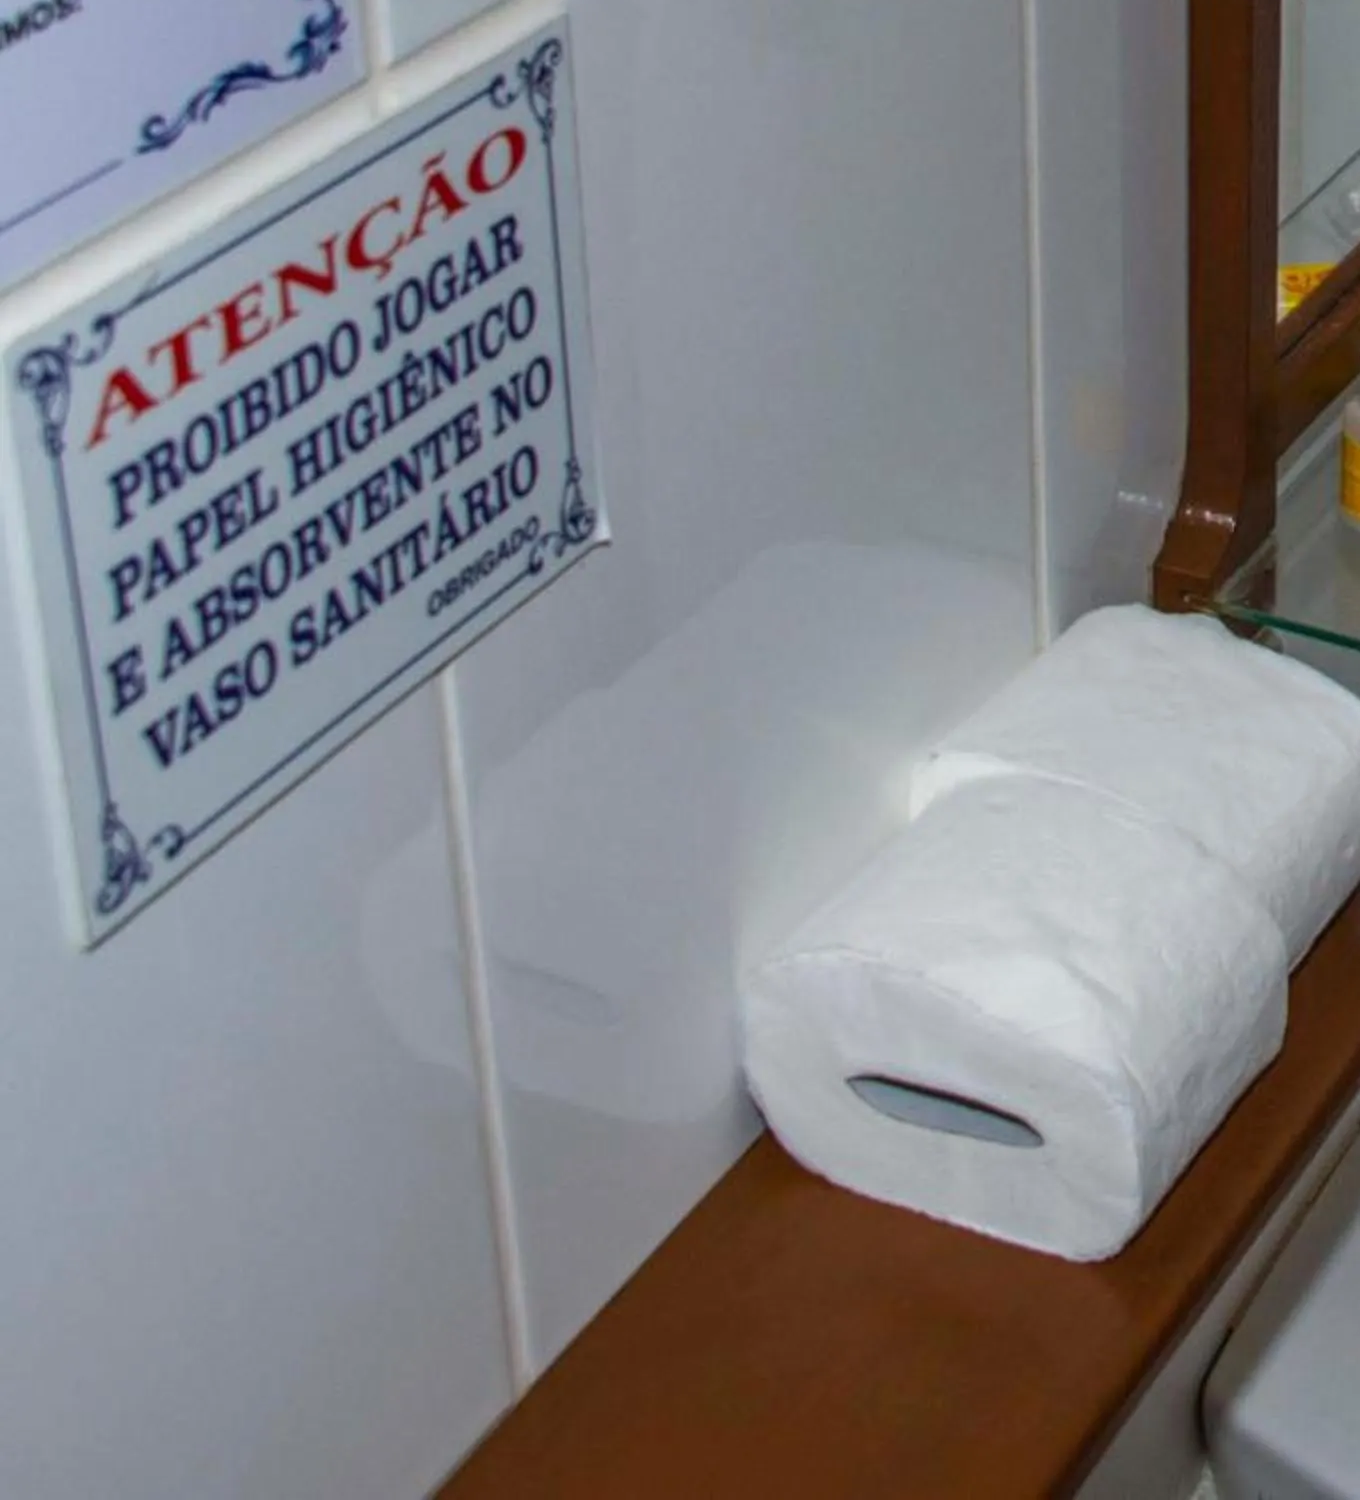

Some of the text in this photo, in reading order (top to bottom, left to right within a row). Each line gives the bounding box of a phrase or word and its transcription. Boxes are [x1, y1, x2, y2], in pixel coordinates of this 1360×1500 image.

[85, 126, 527, 452] ATENÇÃO
[108, 214, 523, 529] PROIBIDO JOGAR
[107, 355, 553, 718] E ABSORVENTE NO
[108, 286, 537, 623] PAPEL HIGIÊNICO
[142, 444, 540, 770] VASO SANITÁRIO
[425, 514, 541, 618] OBRIGADO
